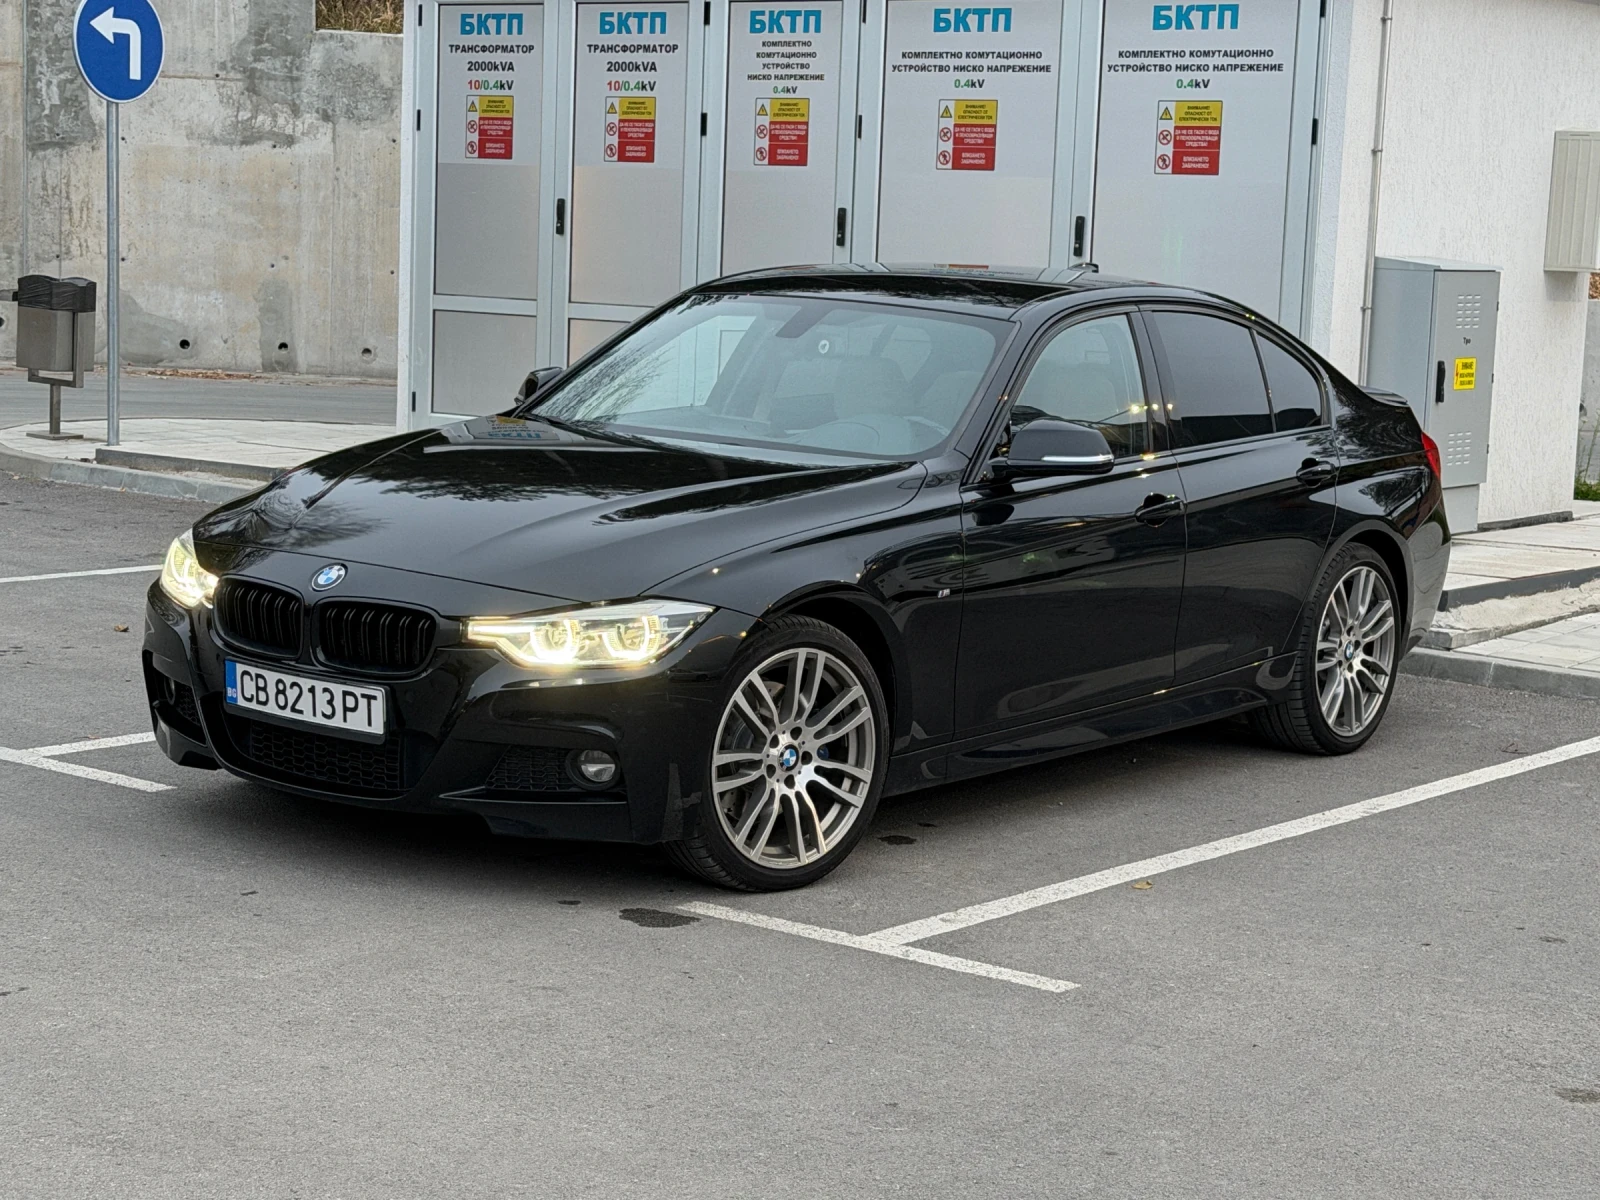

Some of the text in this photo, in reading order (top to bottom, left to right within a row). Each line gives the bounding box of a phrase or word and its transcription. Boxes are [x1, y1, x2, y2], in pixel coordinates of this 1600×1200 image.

[749, 10, 822, 34] БКТП
[933, 8, 1012, 33] БКТП
[1152, 4, 1239, 30] БКТП
[460, 13, 523, 35] БКТП
[599, 12, 667, 34] БКТП
[448, 44, 535, 54] ТРАНСФОРМАТОР
[587, 44, 679, 54] ТРАНСФОРМАТОР
[1118, 49, 1274, 60] КОМПЛЕКТНО КОМУТАЦИОННО
[756, 51, 817, 60] КОМУТАЦИОННО
[901, 51, 1043, 61] КОМПЛЕКТНО КОМУТАЦИОННО
[467, 61, 515, 72] 2000kVA
[606, 61, 657, 73] 2000kVA
[762, 62, 811, 70] УСТРОЙСТВО
[891, 63, 1052, 73] УСТРОЙСТВО НИСКО НАПРЕЖЕНИЕ
[1107, 63, 1285, 73] УСТРОЙСТВО НИСКО НАПРЕЖЕНИЕ
[774, 73, 825, 81] НАПРЕЖЕНИЕ
[468, 80, 514, 91] 10/0.4kV
[607, 80, 657, 92] 10/0.4kV
[954, 79, 985, 89] 0.4kV
[1176, 79, 1211, 89] 0.4kV
[773, 86, 798, 94] 0.4kV
[227, 687, 237, 698] BG
[240, 669, 378, 728] CB 8213 PT
